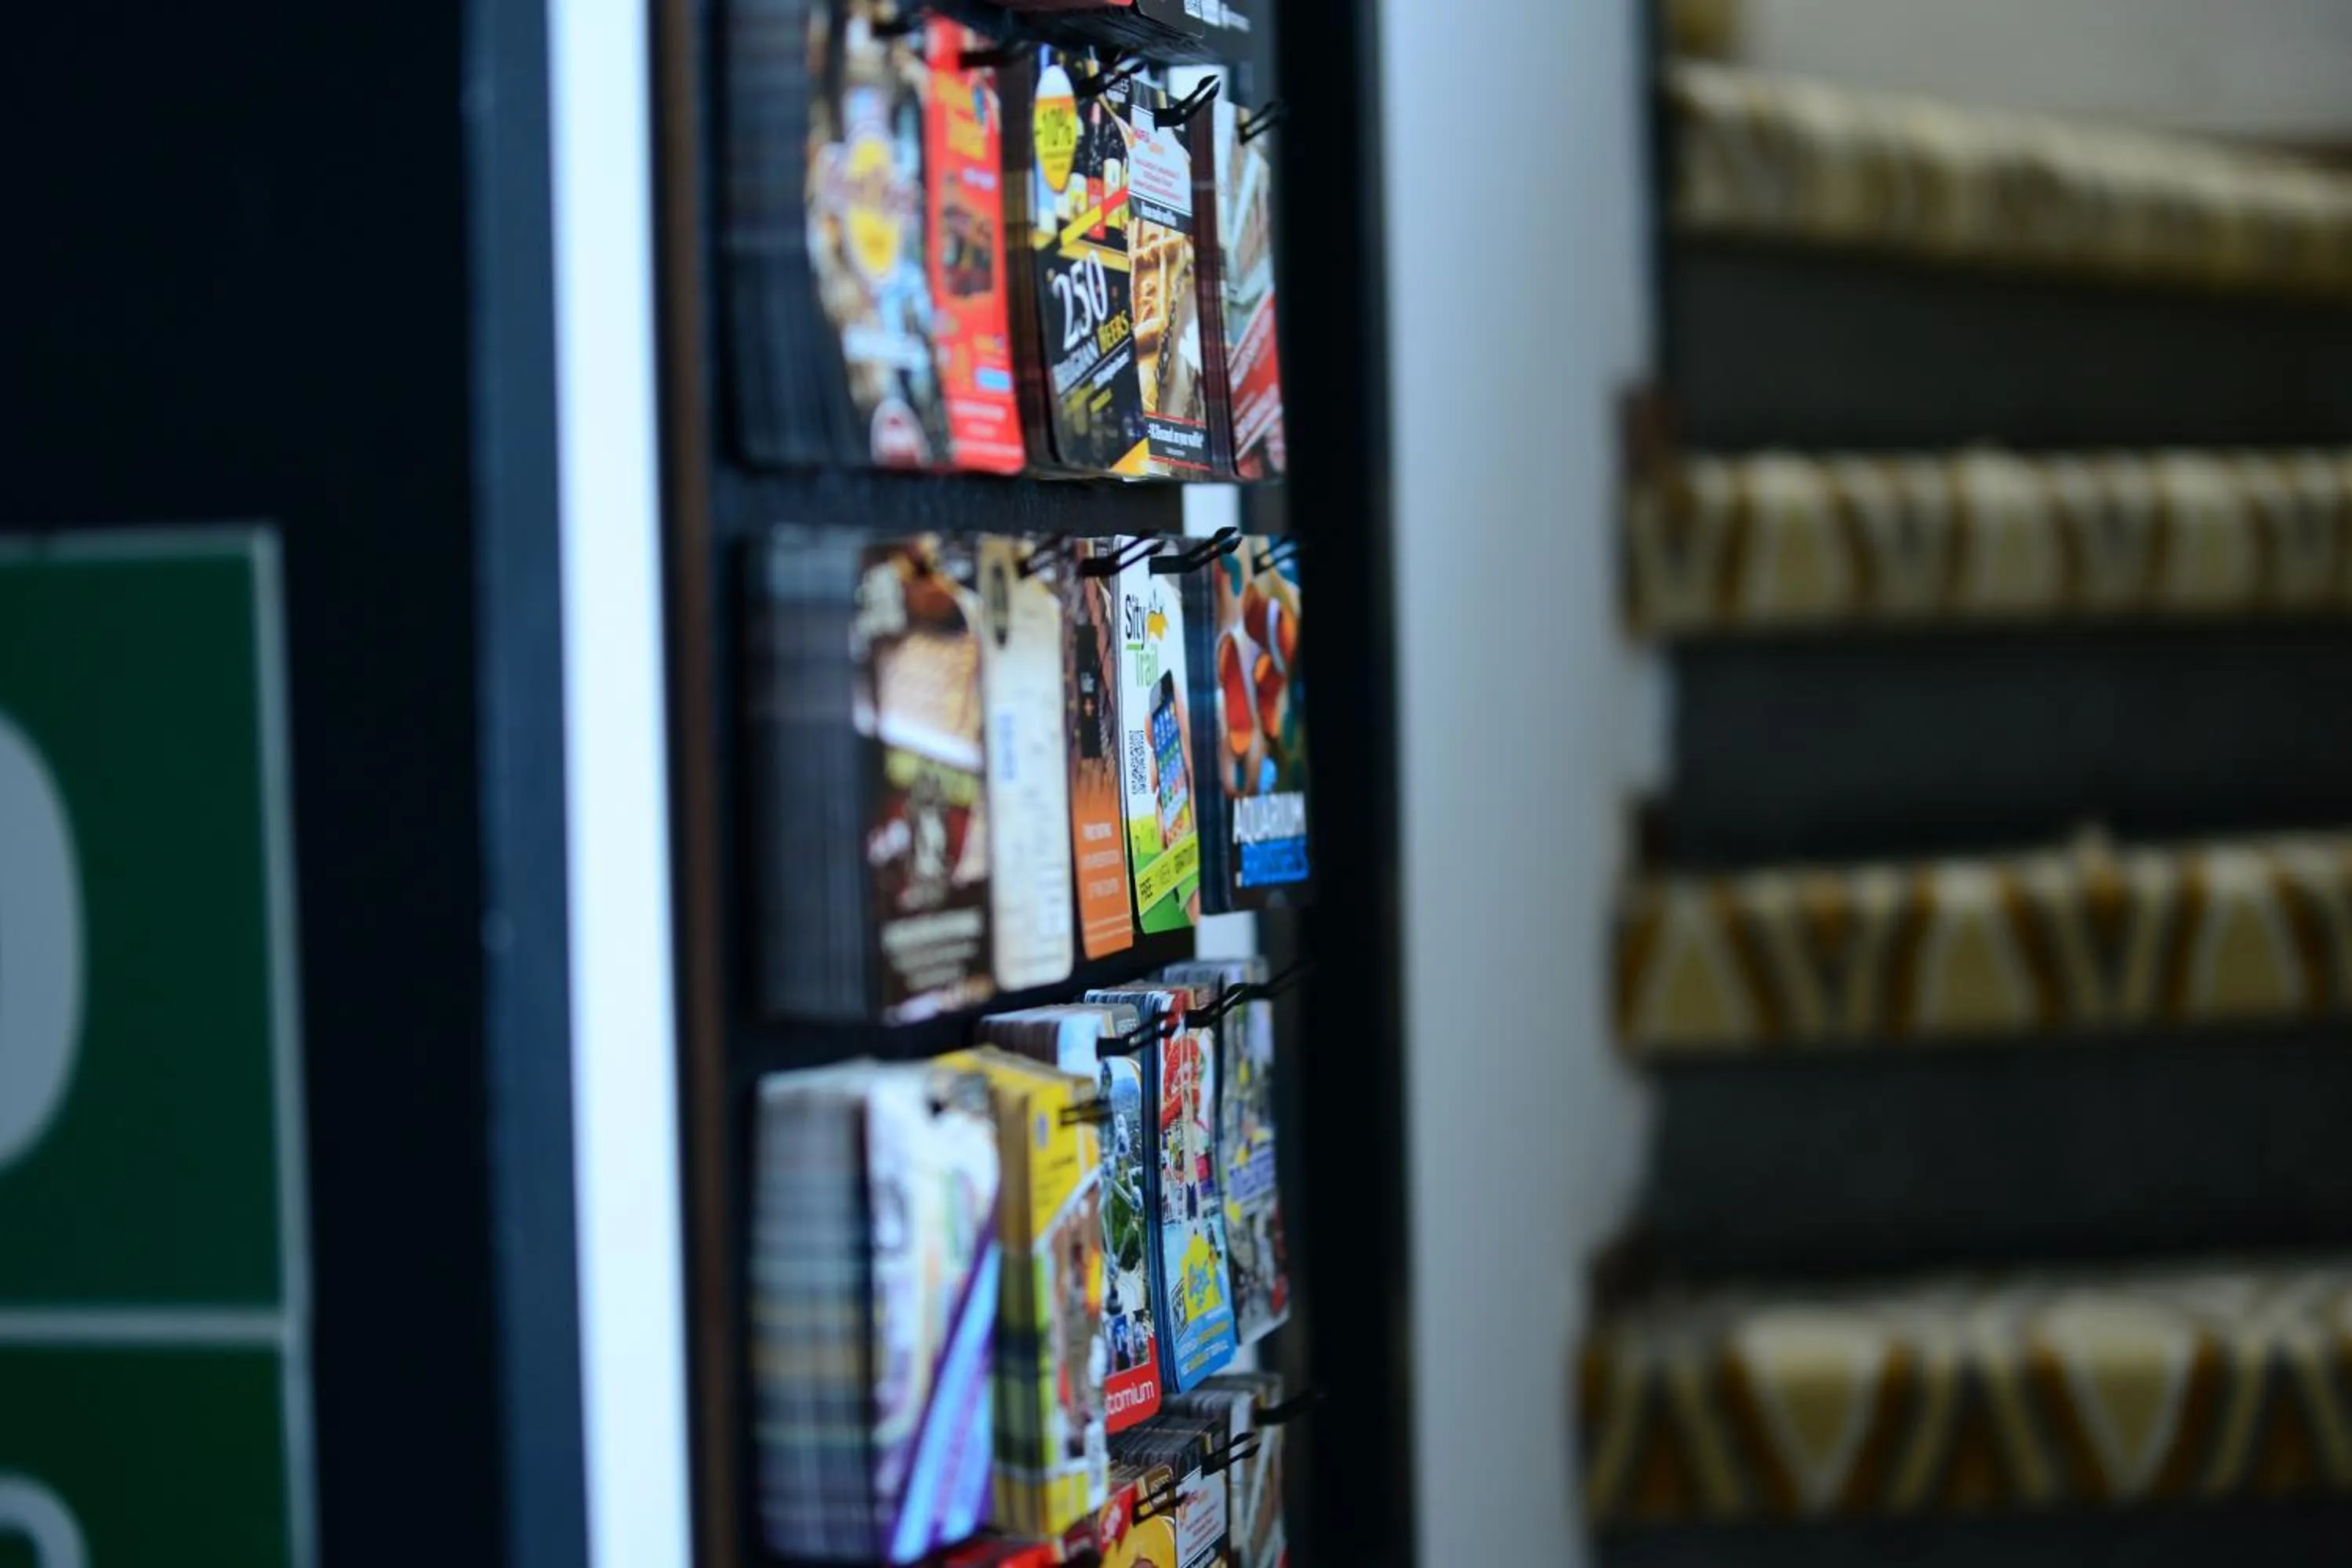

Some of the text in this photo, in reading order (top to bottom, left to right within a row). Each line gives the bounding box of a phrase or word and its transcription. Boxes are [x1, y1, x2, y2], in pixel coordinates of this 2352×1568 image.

[1052, 249, 1109, 351] 250
[1098, 310, 1130, 354] BEERS
[1125, 593, 1146, 650] Sity
[1136, 644, 1159, 687] Trail
[1105, 1380, 1155, 1414] tomium
